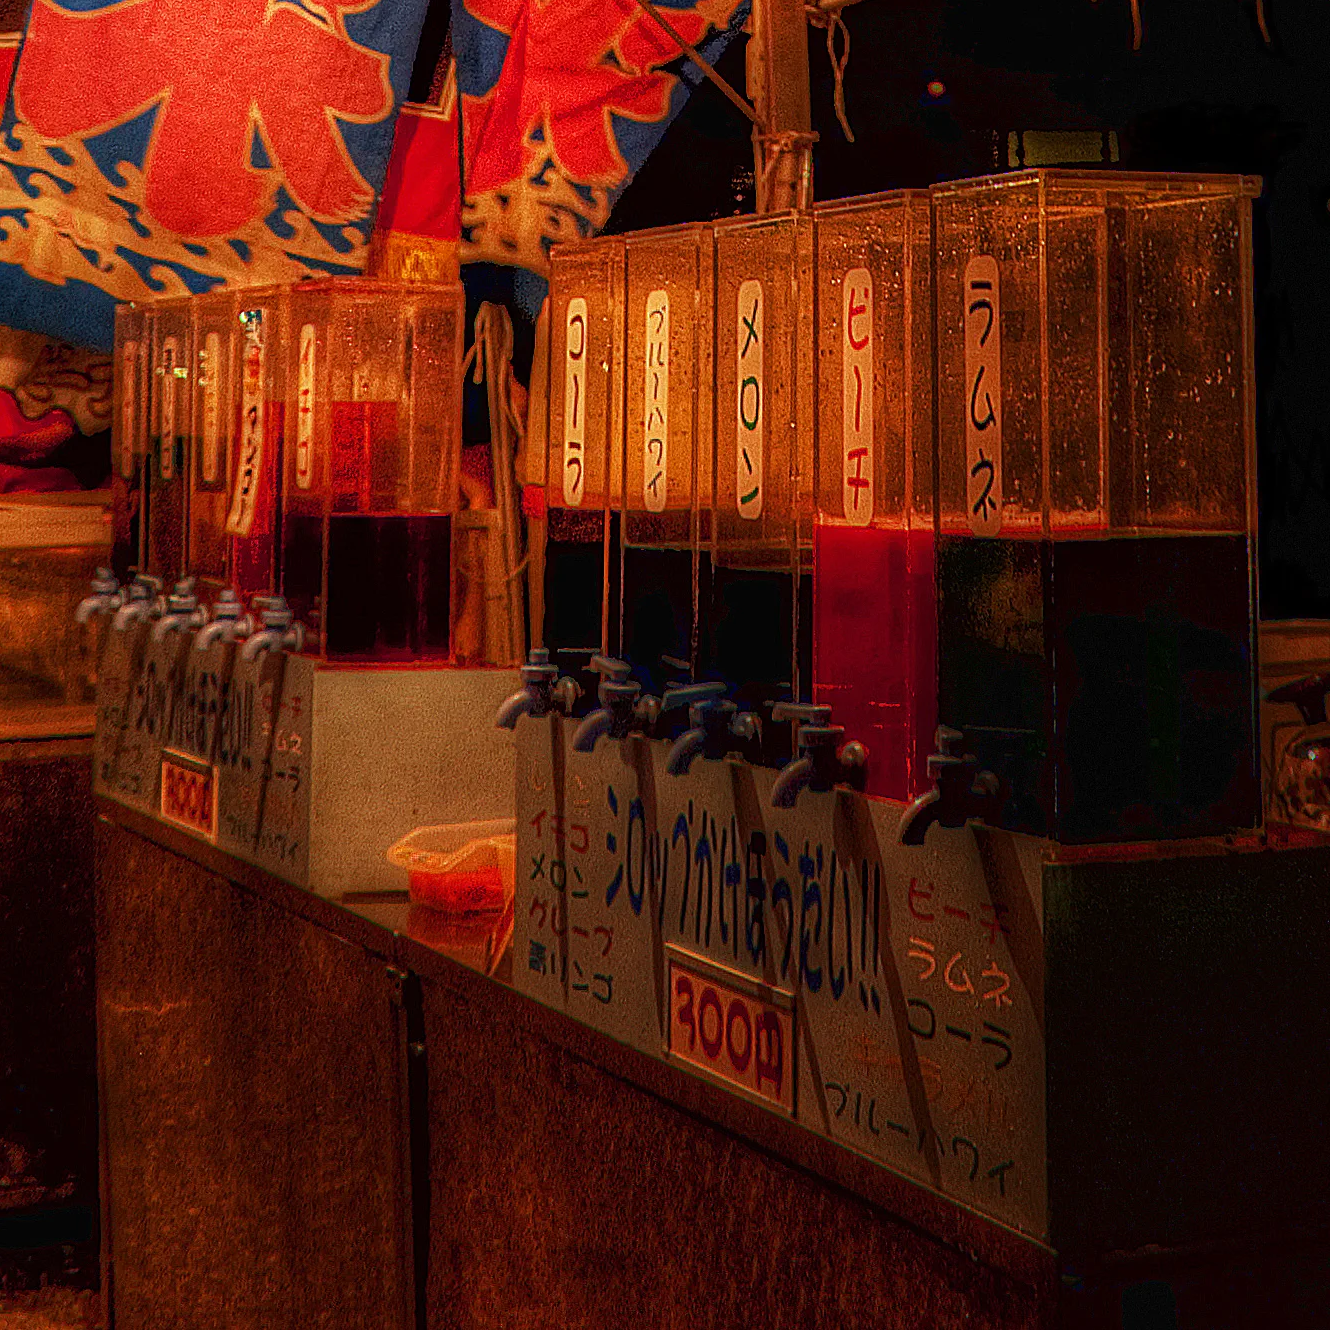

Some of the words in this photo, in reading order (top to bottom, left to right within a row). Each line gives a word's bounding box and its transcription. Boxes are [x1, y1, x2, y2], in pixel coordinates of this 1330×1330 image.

[566, 315, 585, 494] コーラ
[740, 299, 760, 504] メロン
[969, 281, 997, 523] ラムネ
[529, 854, 590, 899] メロン
[906, 998, 1013, 1070] コーラ
[907, 936, 1013, 1010] ラムネ
[675, 976, 784, 1102] 300円
